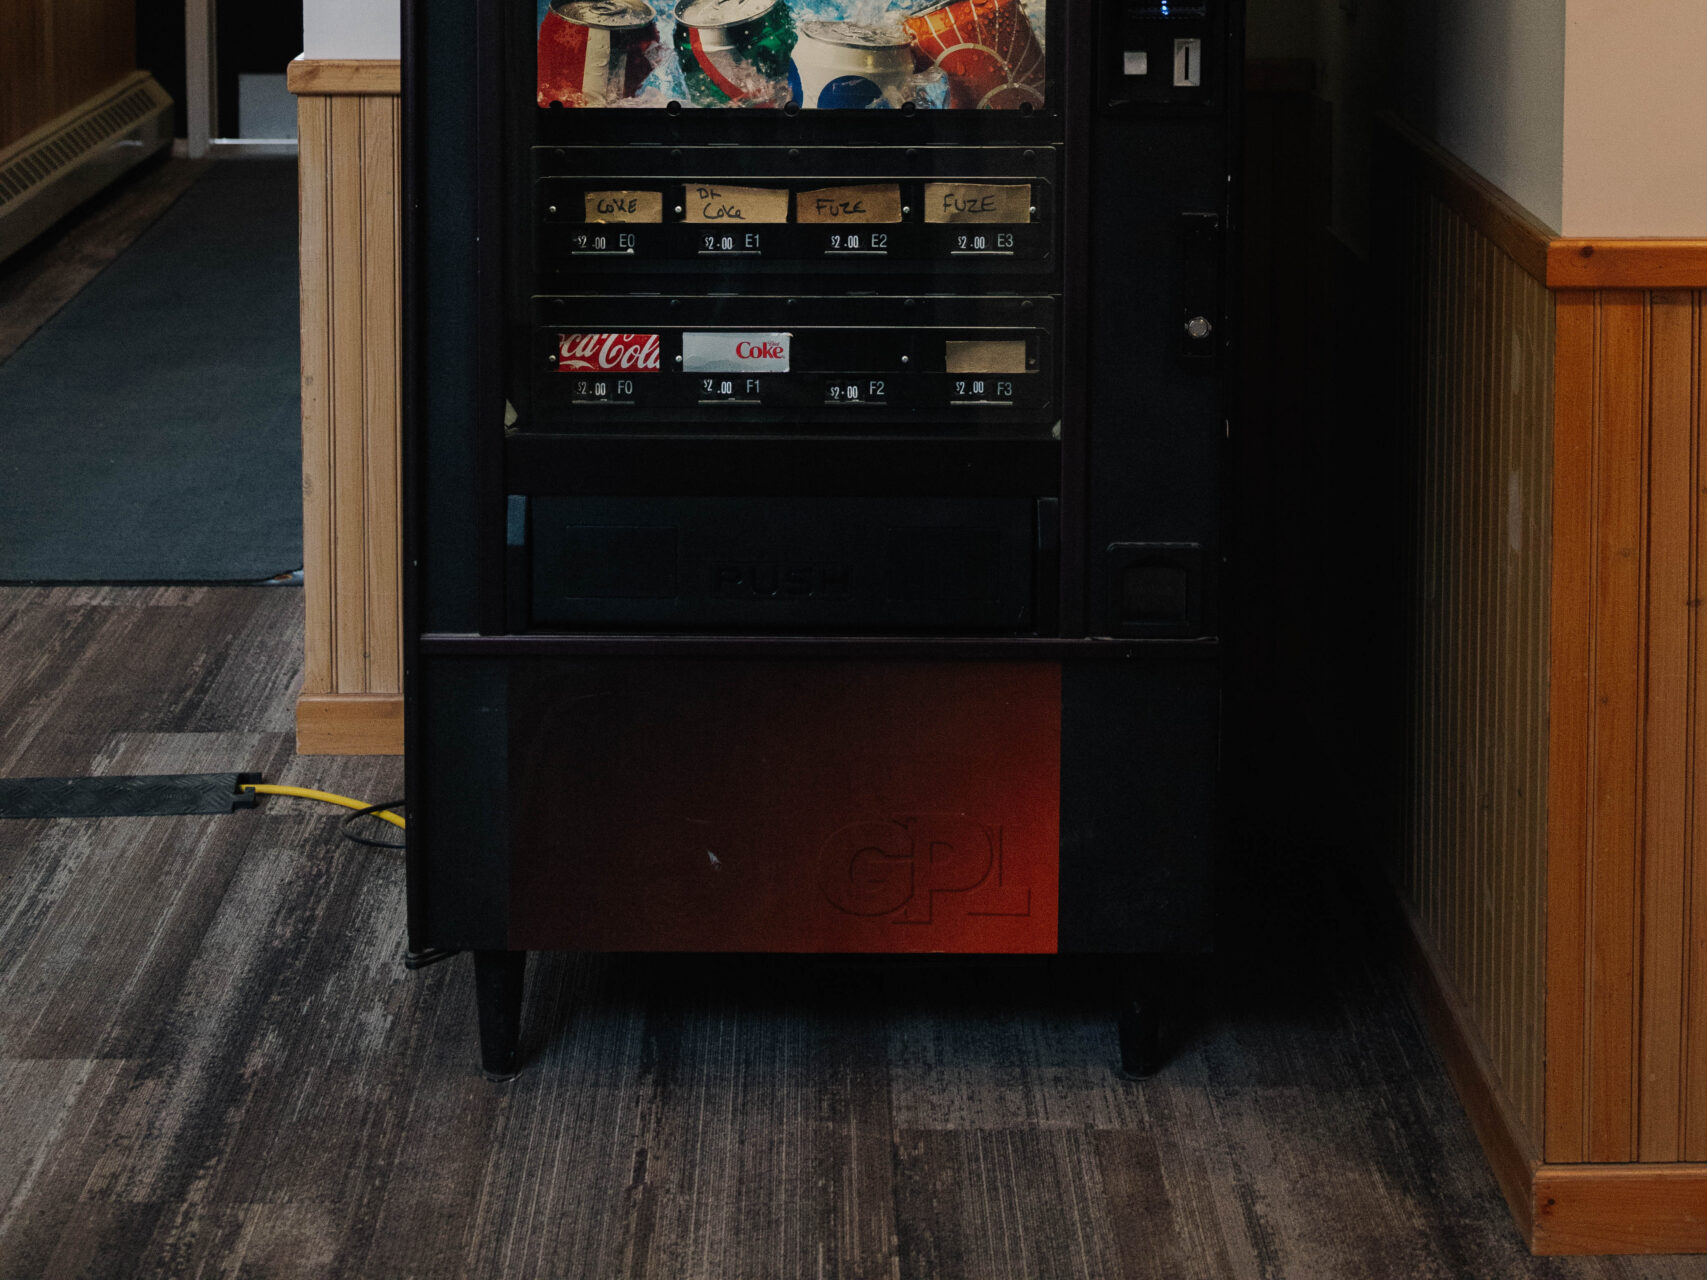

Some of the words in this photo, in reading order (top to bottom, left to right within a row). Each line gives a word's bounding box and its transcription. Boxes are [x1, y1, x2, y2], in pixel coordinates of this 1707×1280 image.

[816, 198, 867, 217] FUZE
[943, 194, 996, 214] FUZE
[578, 234, 606, 250] $2.00
[619, 233, 635, 248] E0
[704, 236, 733, 250] $2.00
[745, 233, 760, 248] E1
[831, 235, 859, 249] $2.00
[871, 234, 888, 248] E2
[958, 235, 985, 250] $2.00
[997, 234, 1014, 248] E3
[736, 341, 784, 359] Coke
[577, 380, 606, 396] $2.00
[617, 380, 633, 394] F0
[703, 379, 732, 395] $2.00
[746, 379, 760, 393] F1
[830, 385, 858, 400] $2.00
[869, 381, 885, 395] F2
[956, 381, 984, 395] $2.00
[997, 382, 1012, 396] F3
